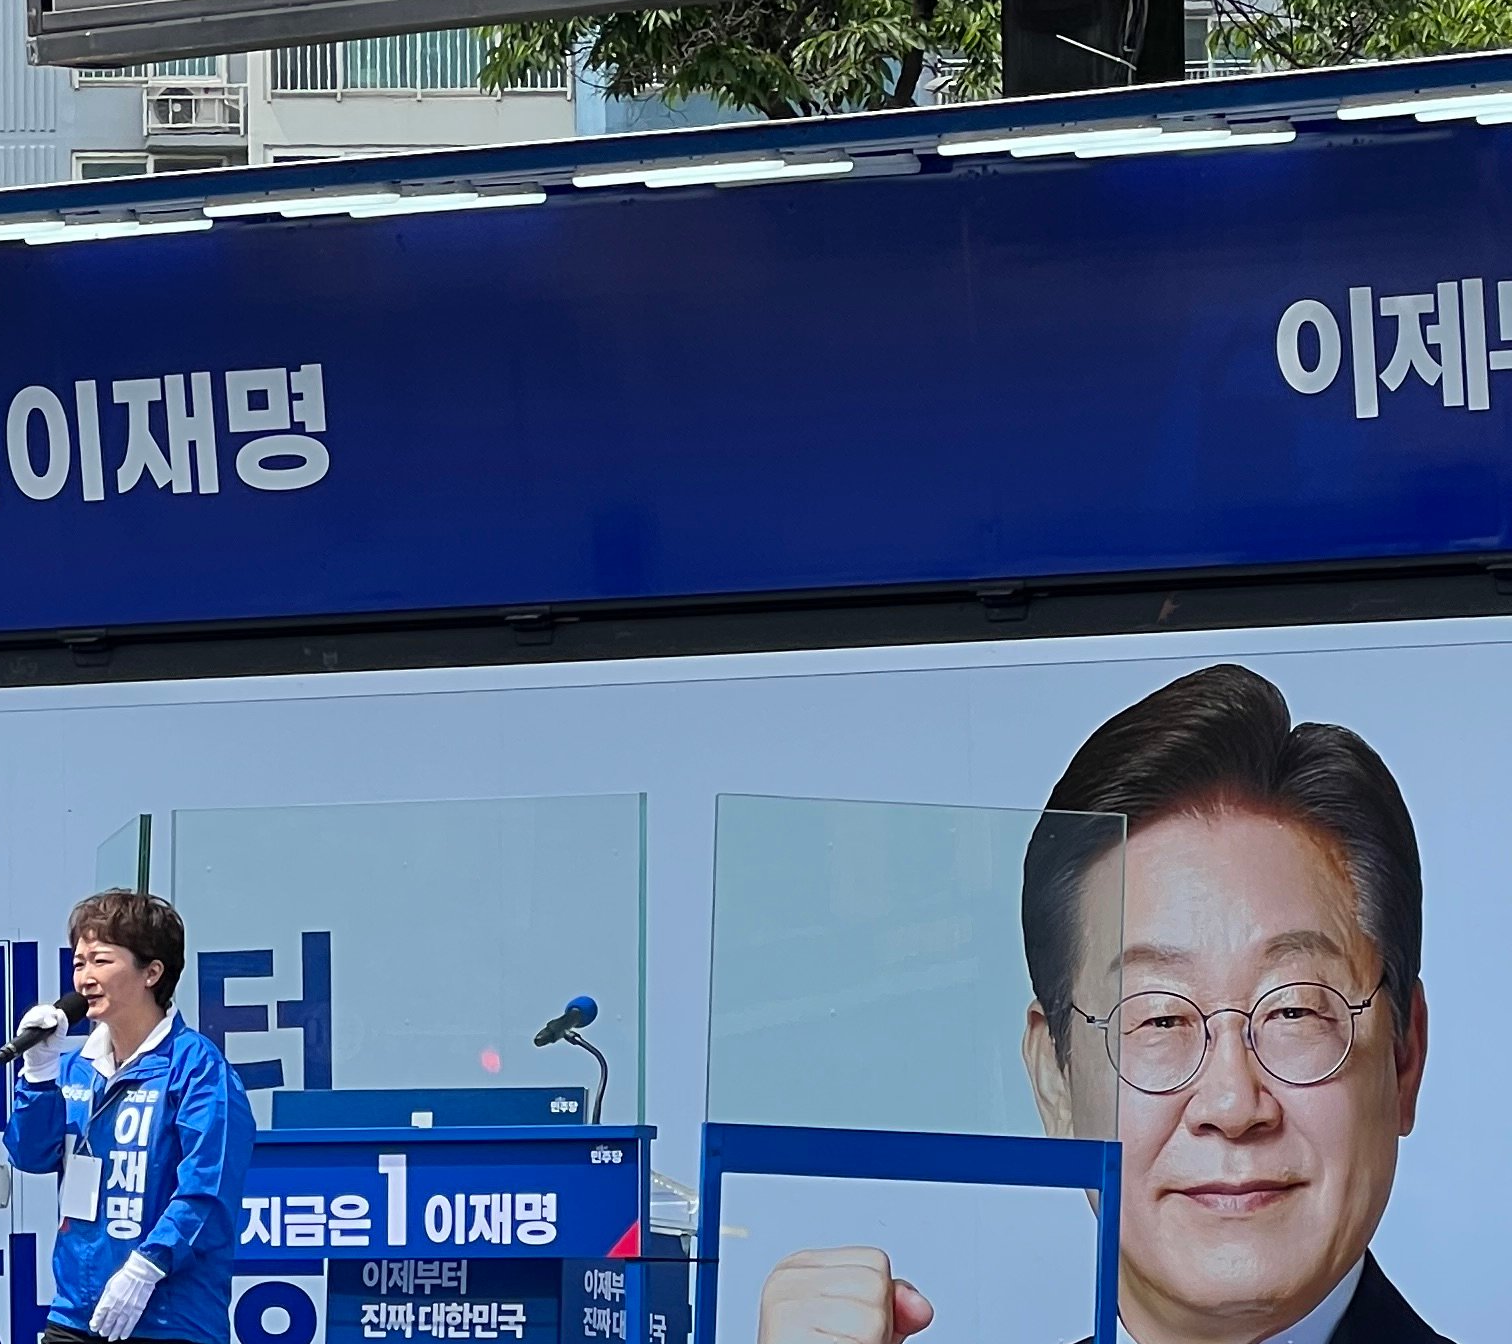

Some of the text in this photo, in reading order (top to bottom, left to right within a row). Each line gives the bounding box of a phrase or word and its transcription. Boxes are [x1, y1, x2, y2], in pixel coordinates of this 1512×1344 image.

[6, 362, 331, 502] 이재명
[123, 1089, 160, 1103] 지금은
[106, 1106, 154, 1240] 이재명
[240, 1154, 558, 1247] 지금은 1 이재명
[362, 1259, 468, 1295] 이제부터
[360, 1302, 527, 1339] 진짜 대한민국
[583, 1307, 611, 1339] 진짜
